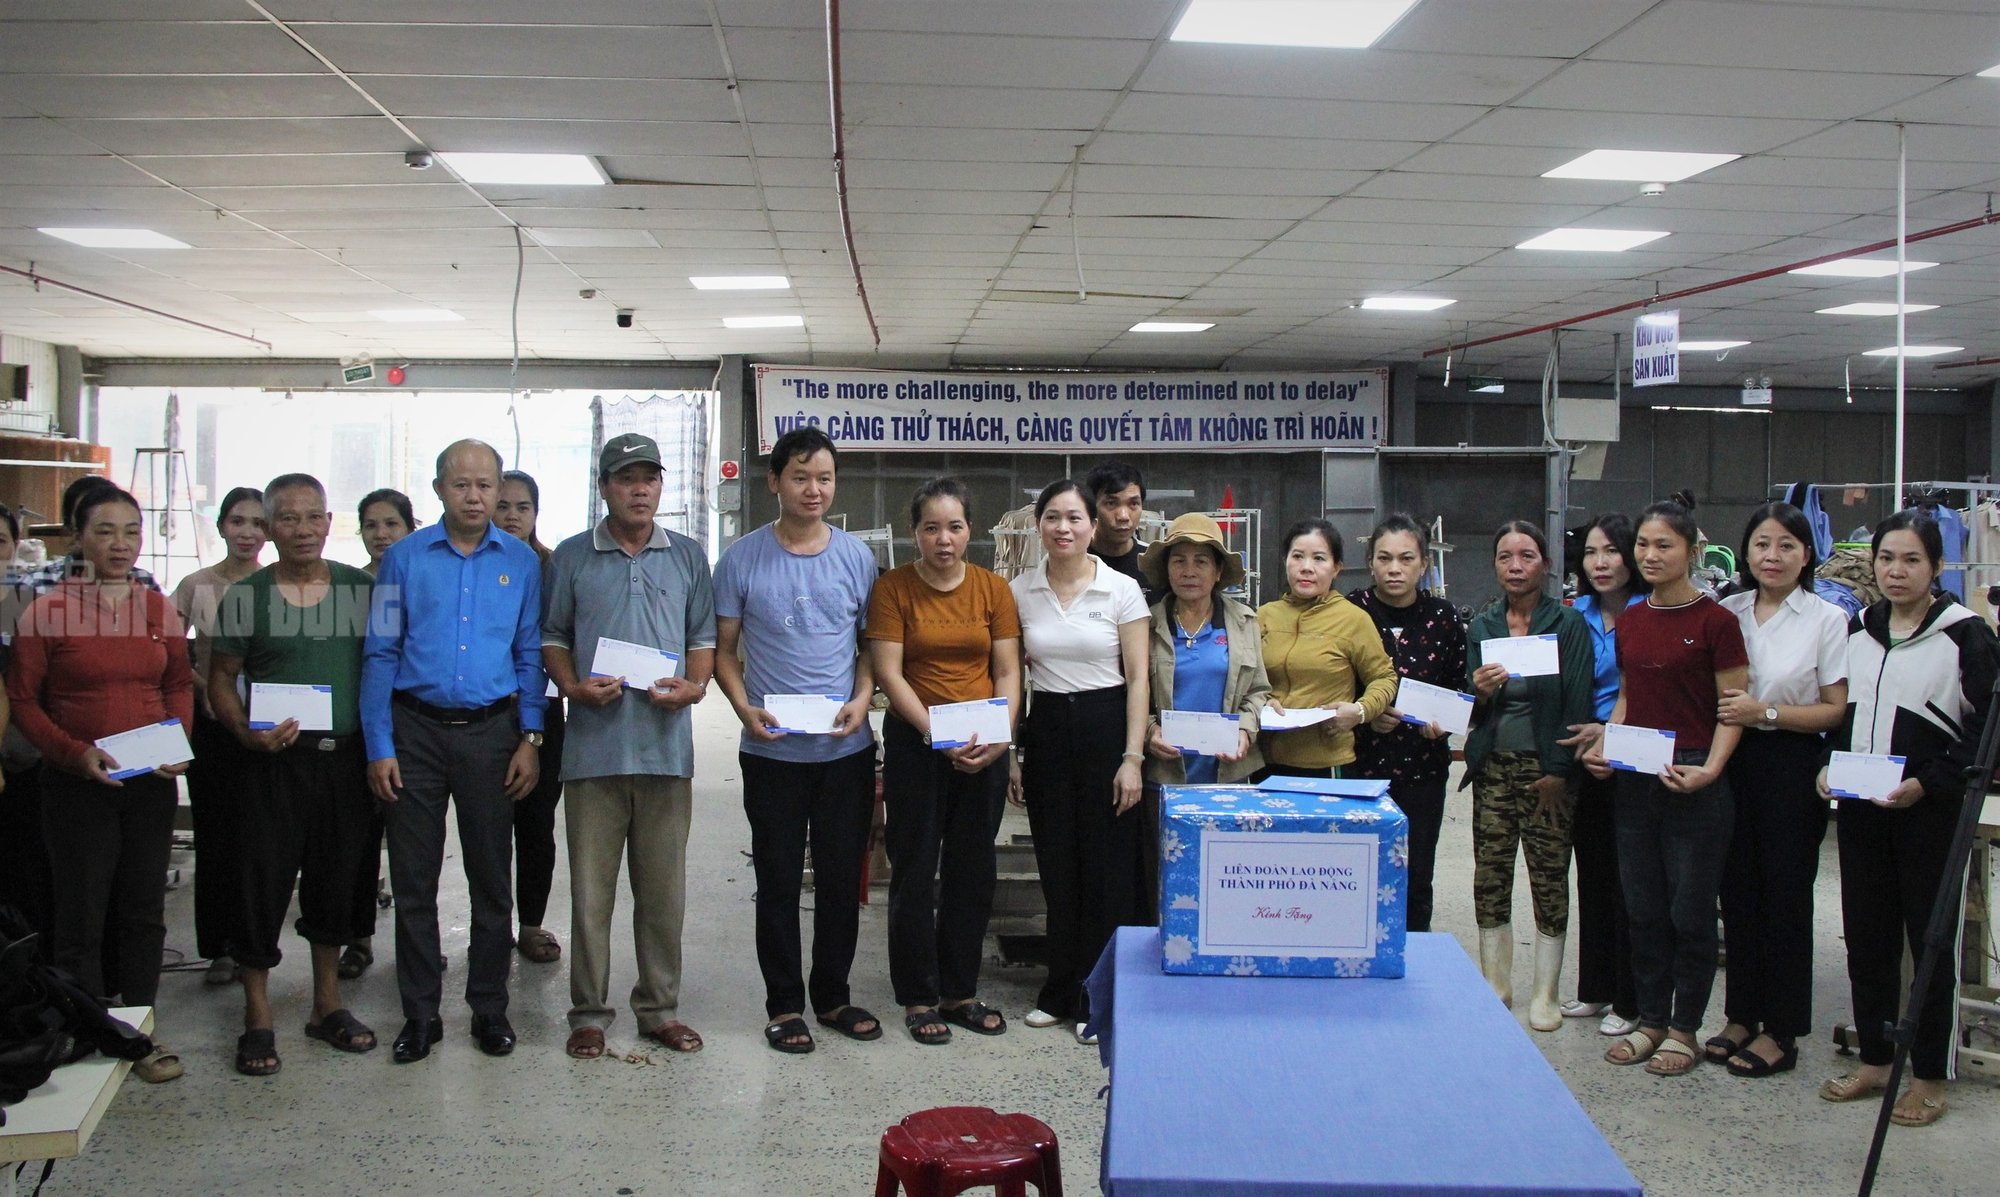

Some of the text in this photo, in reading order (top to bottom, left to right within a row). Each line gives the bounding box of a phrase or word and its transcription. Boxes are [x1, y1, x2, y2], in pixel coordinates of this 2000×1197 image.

[1636, 325, 1652, 347] KHU
[1635, 347, 1676, 380] SẢN XUẤT
[782, 378, 1369, 403] "The more challenging, the more determined not to delay"
[827, 411, 884, 441] CÀNG
[891, 408, 932, 441] THỬ
[936, 411, 1010, 444] THÁCH,
[1016, 411, 1073, 442] CÀNG
[1079, 409, 1143, 444] QUYẾT
[1149, 412, 1193, 442] TÂM
[1199, 412, 1268, 442] KHÔNG
[1273, 411, 1304, 441] TRÌ
[1311, 411, 1364, 440] HOÃN
[1224, 863, 1353, 878] LIÊN ĐOÀN LAO ĐỘNG
[1218, 876, 1264, 889] THÀNH
[1299, 877, 1317, 890] ĐÀ
